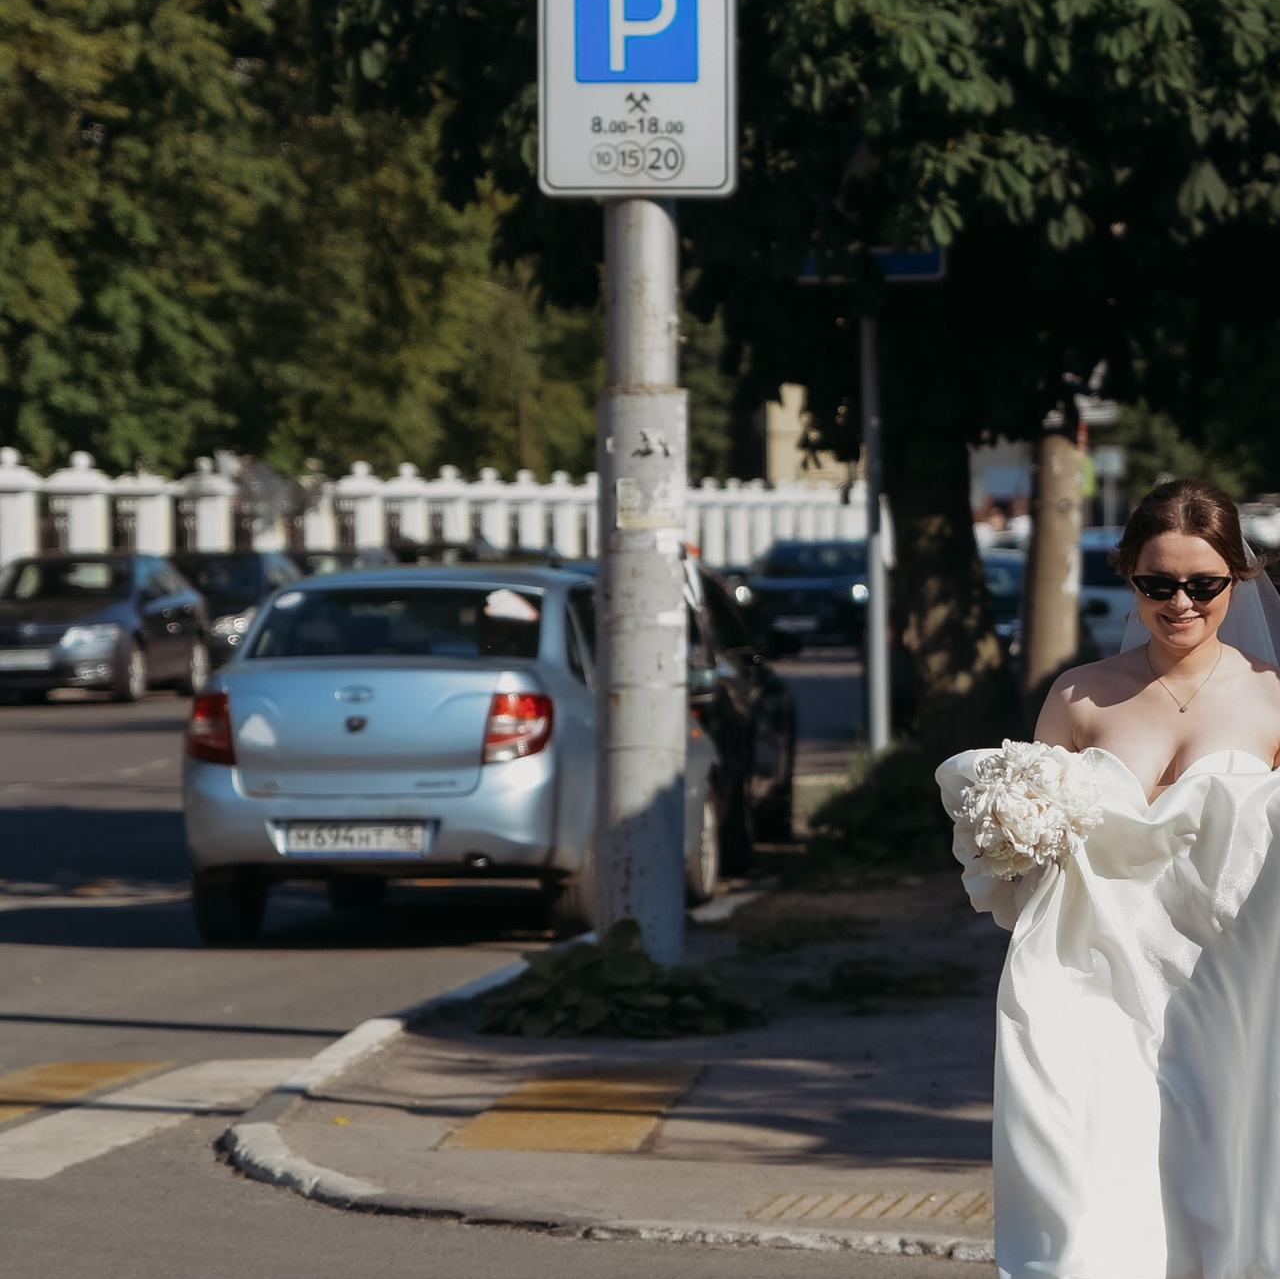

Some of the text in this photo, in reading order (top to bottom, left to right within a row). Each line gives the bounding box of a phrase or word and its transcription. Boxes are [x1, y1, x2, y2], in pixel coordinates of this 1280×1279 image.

[596, 148, 679, 171] 10 15 20
